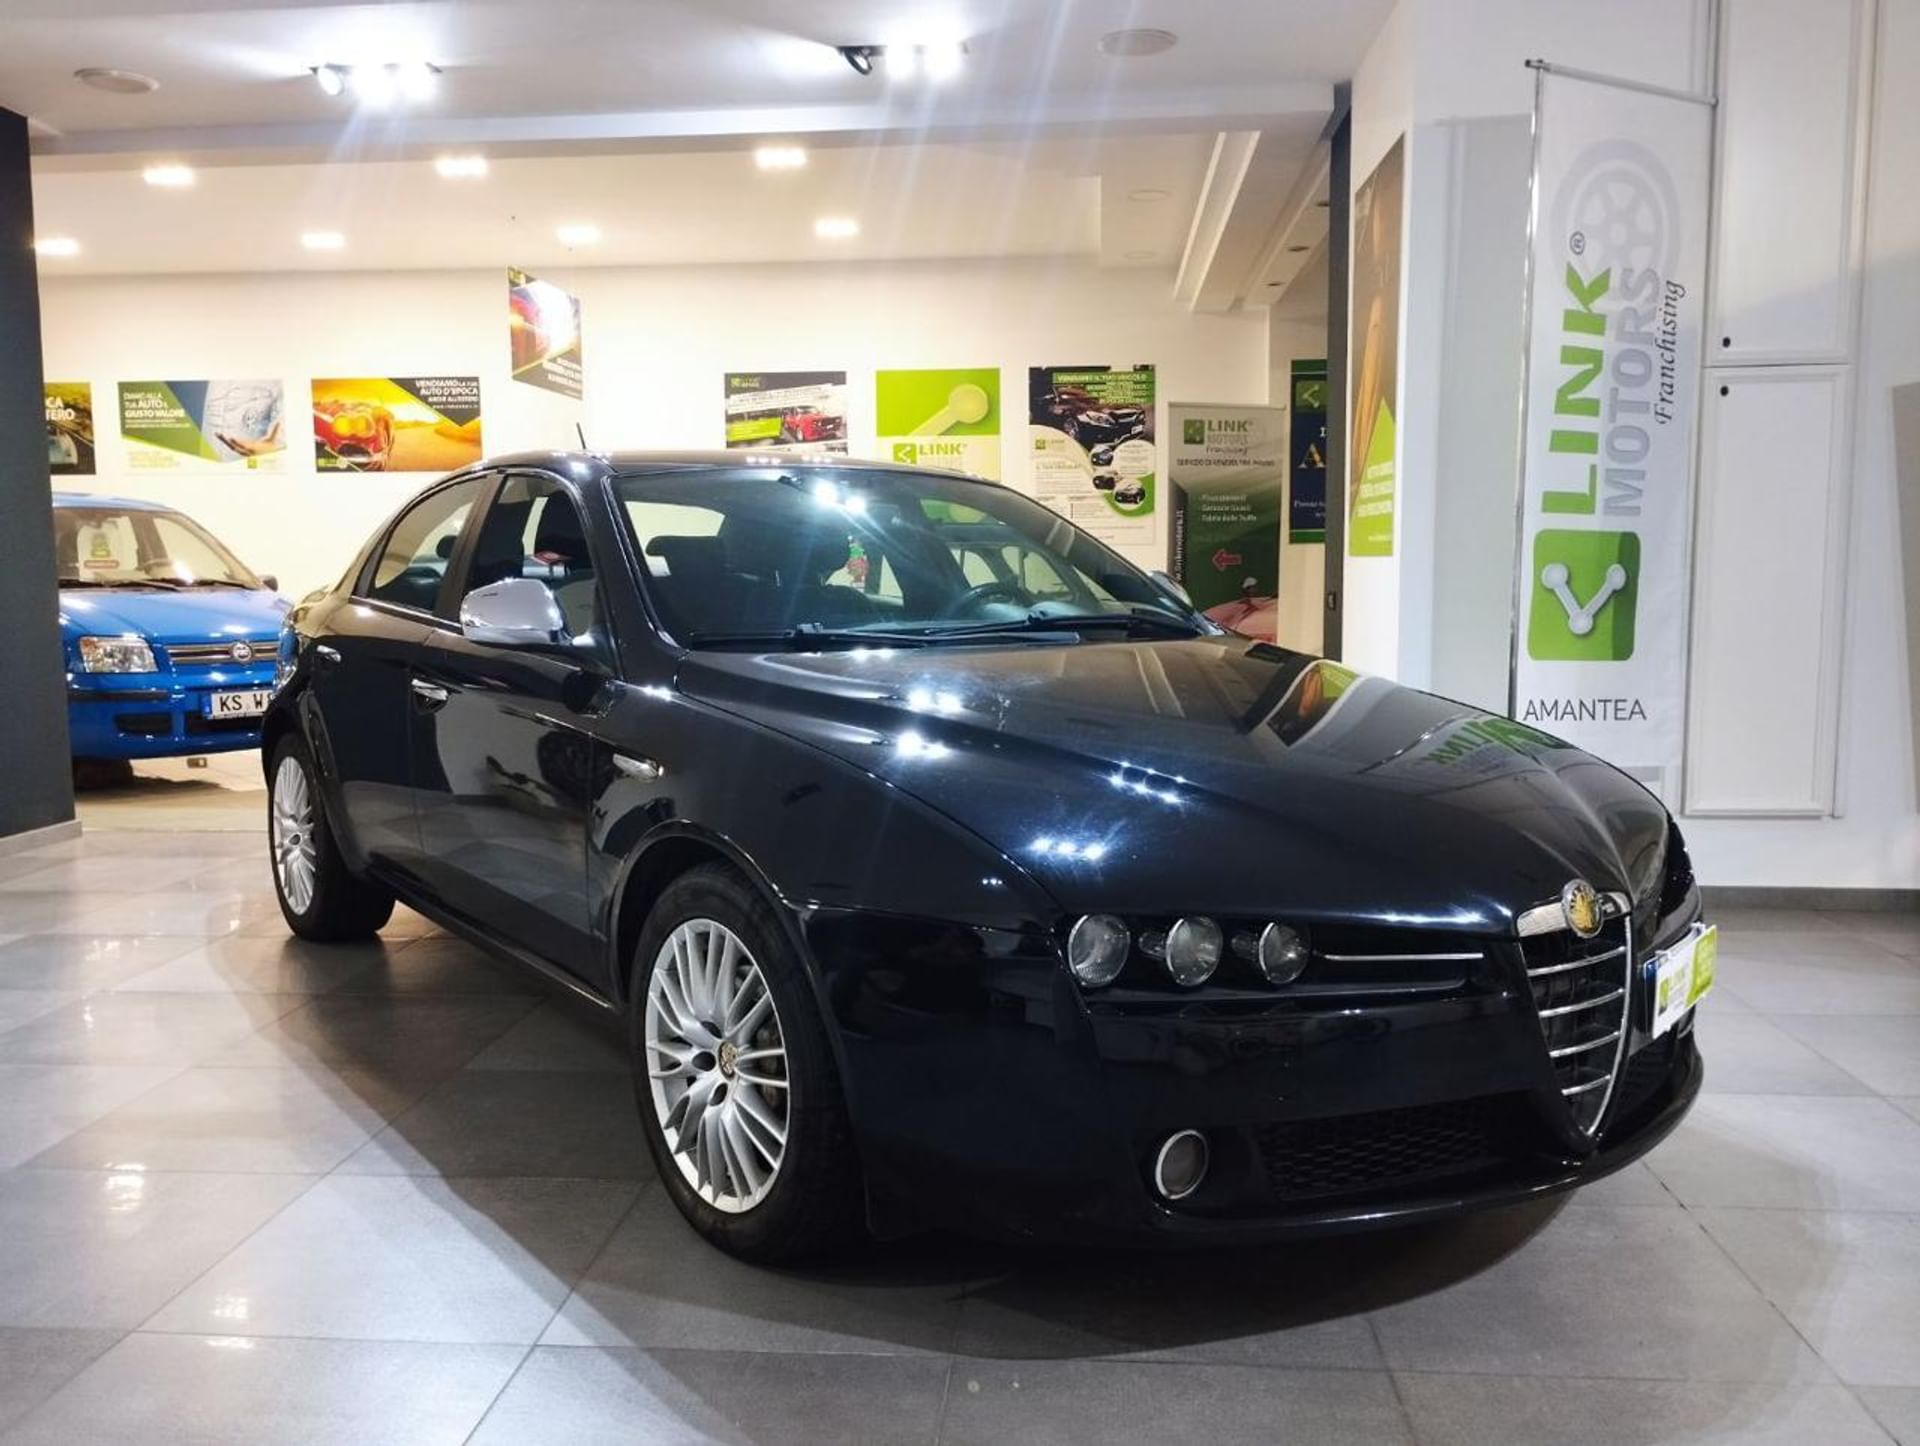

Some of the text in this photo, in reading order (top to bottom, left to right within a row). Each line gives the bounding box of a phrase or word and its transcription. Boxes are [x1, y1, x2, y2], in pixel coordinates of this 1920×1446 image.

[1654, 280, 1686, 425] Franchising
[420, 387, 442, 396] AUTO
[1541, 261, 1612, 516] LINK
[1603, 267, 1661, 517] MOTORS
[46, 397, 64, 409] CA
[138, 400, 163, 408] AUTO
[46, 409, 76, 421] TERO
[124, 408, 185, 418] GIUSTO VALORE
[1207, 420, 1249, 432] LINK
[919, 443, 962, 456] LINK
[219, 695, 243, 712] KS
[1523, 699, 1647, 722] AMANTEA
